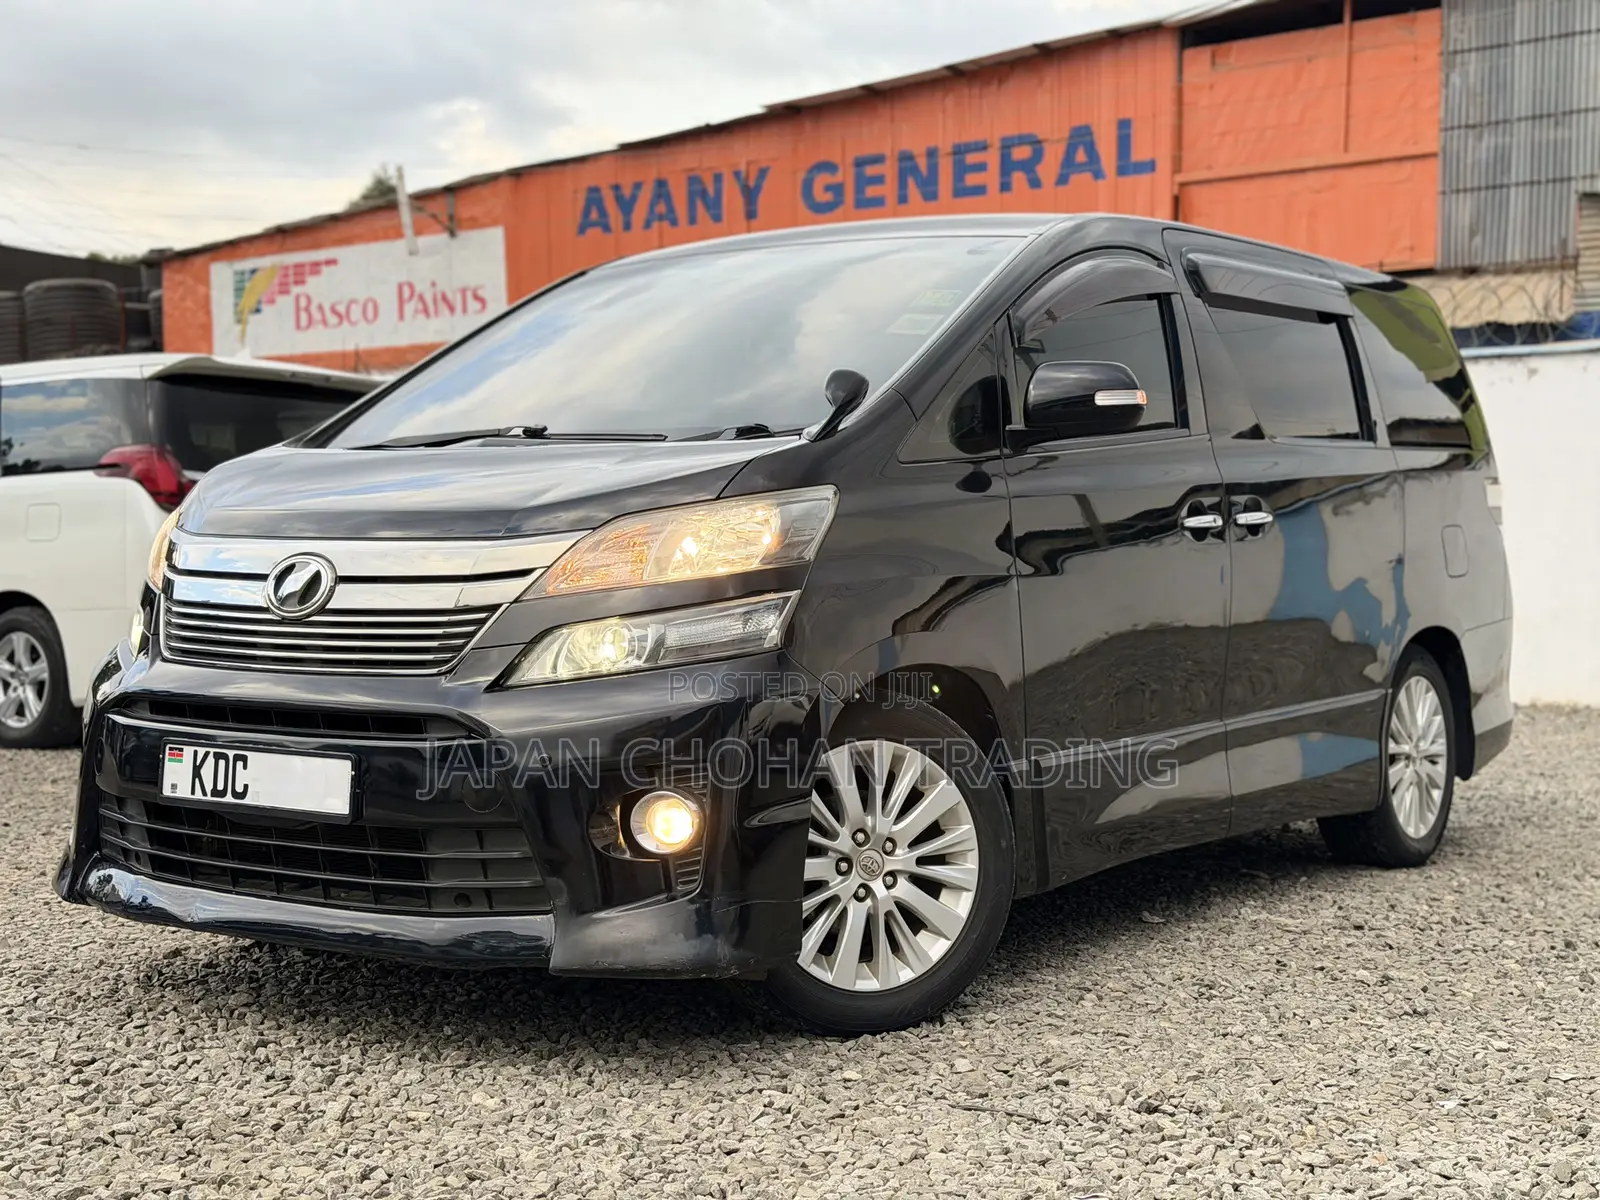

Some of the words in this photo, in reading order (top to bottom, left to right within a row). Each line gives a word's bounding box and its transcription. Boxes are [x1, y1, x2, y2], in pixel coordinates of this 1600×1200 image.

[576, 165, 772, 236] AYANY
[801, 118, 1156, 215] GENERAL
[190, 749, 249, 800] KDC
